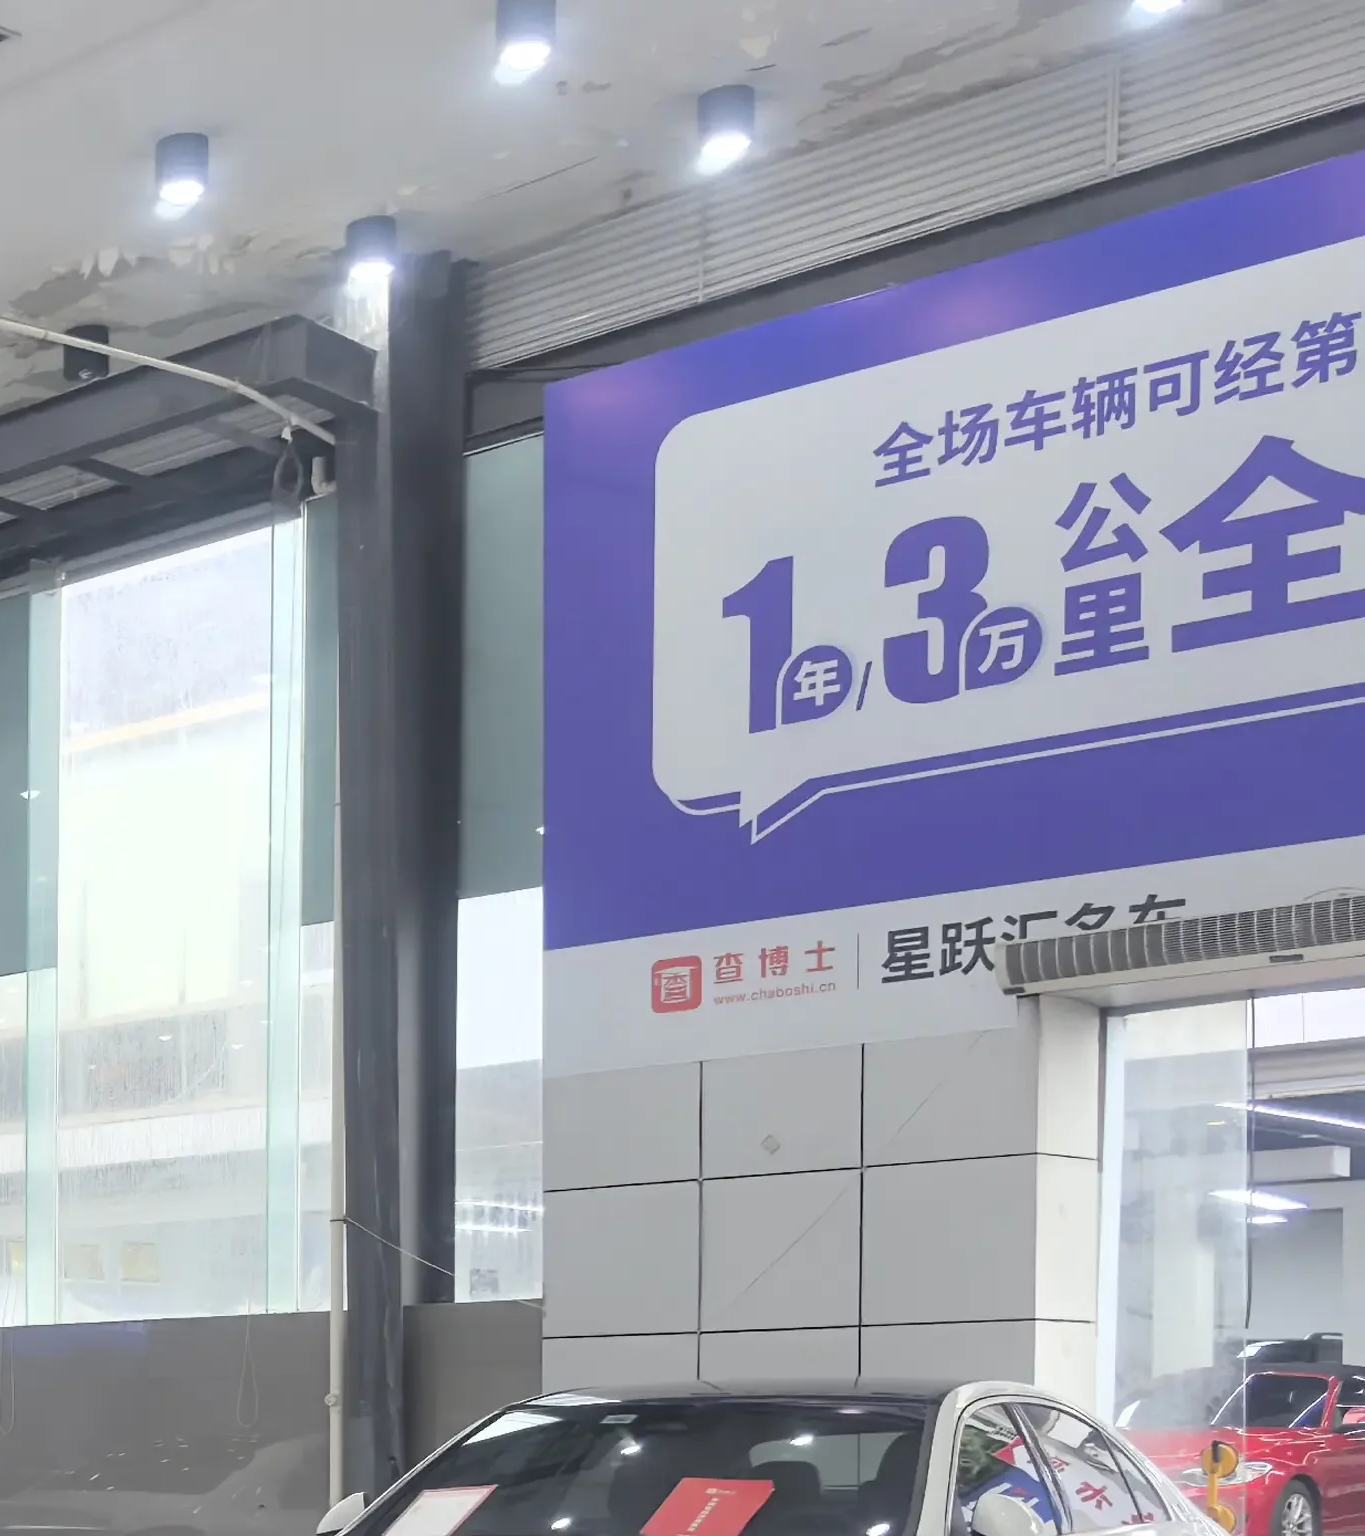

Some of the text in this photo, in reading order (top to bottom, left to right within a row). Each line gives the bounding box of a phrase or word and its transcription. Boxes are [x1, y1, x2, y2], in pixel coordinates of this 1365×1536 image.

[873, 312, 1361, 487] 全场车辆可经第
[714, 940, 836, 985] 查博士
[714, 981, 837, 1006] www.chaboshi.cn
